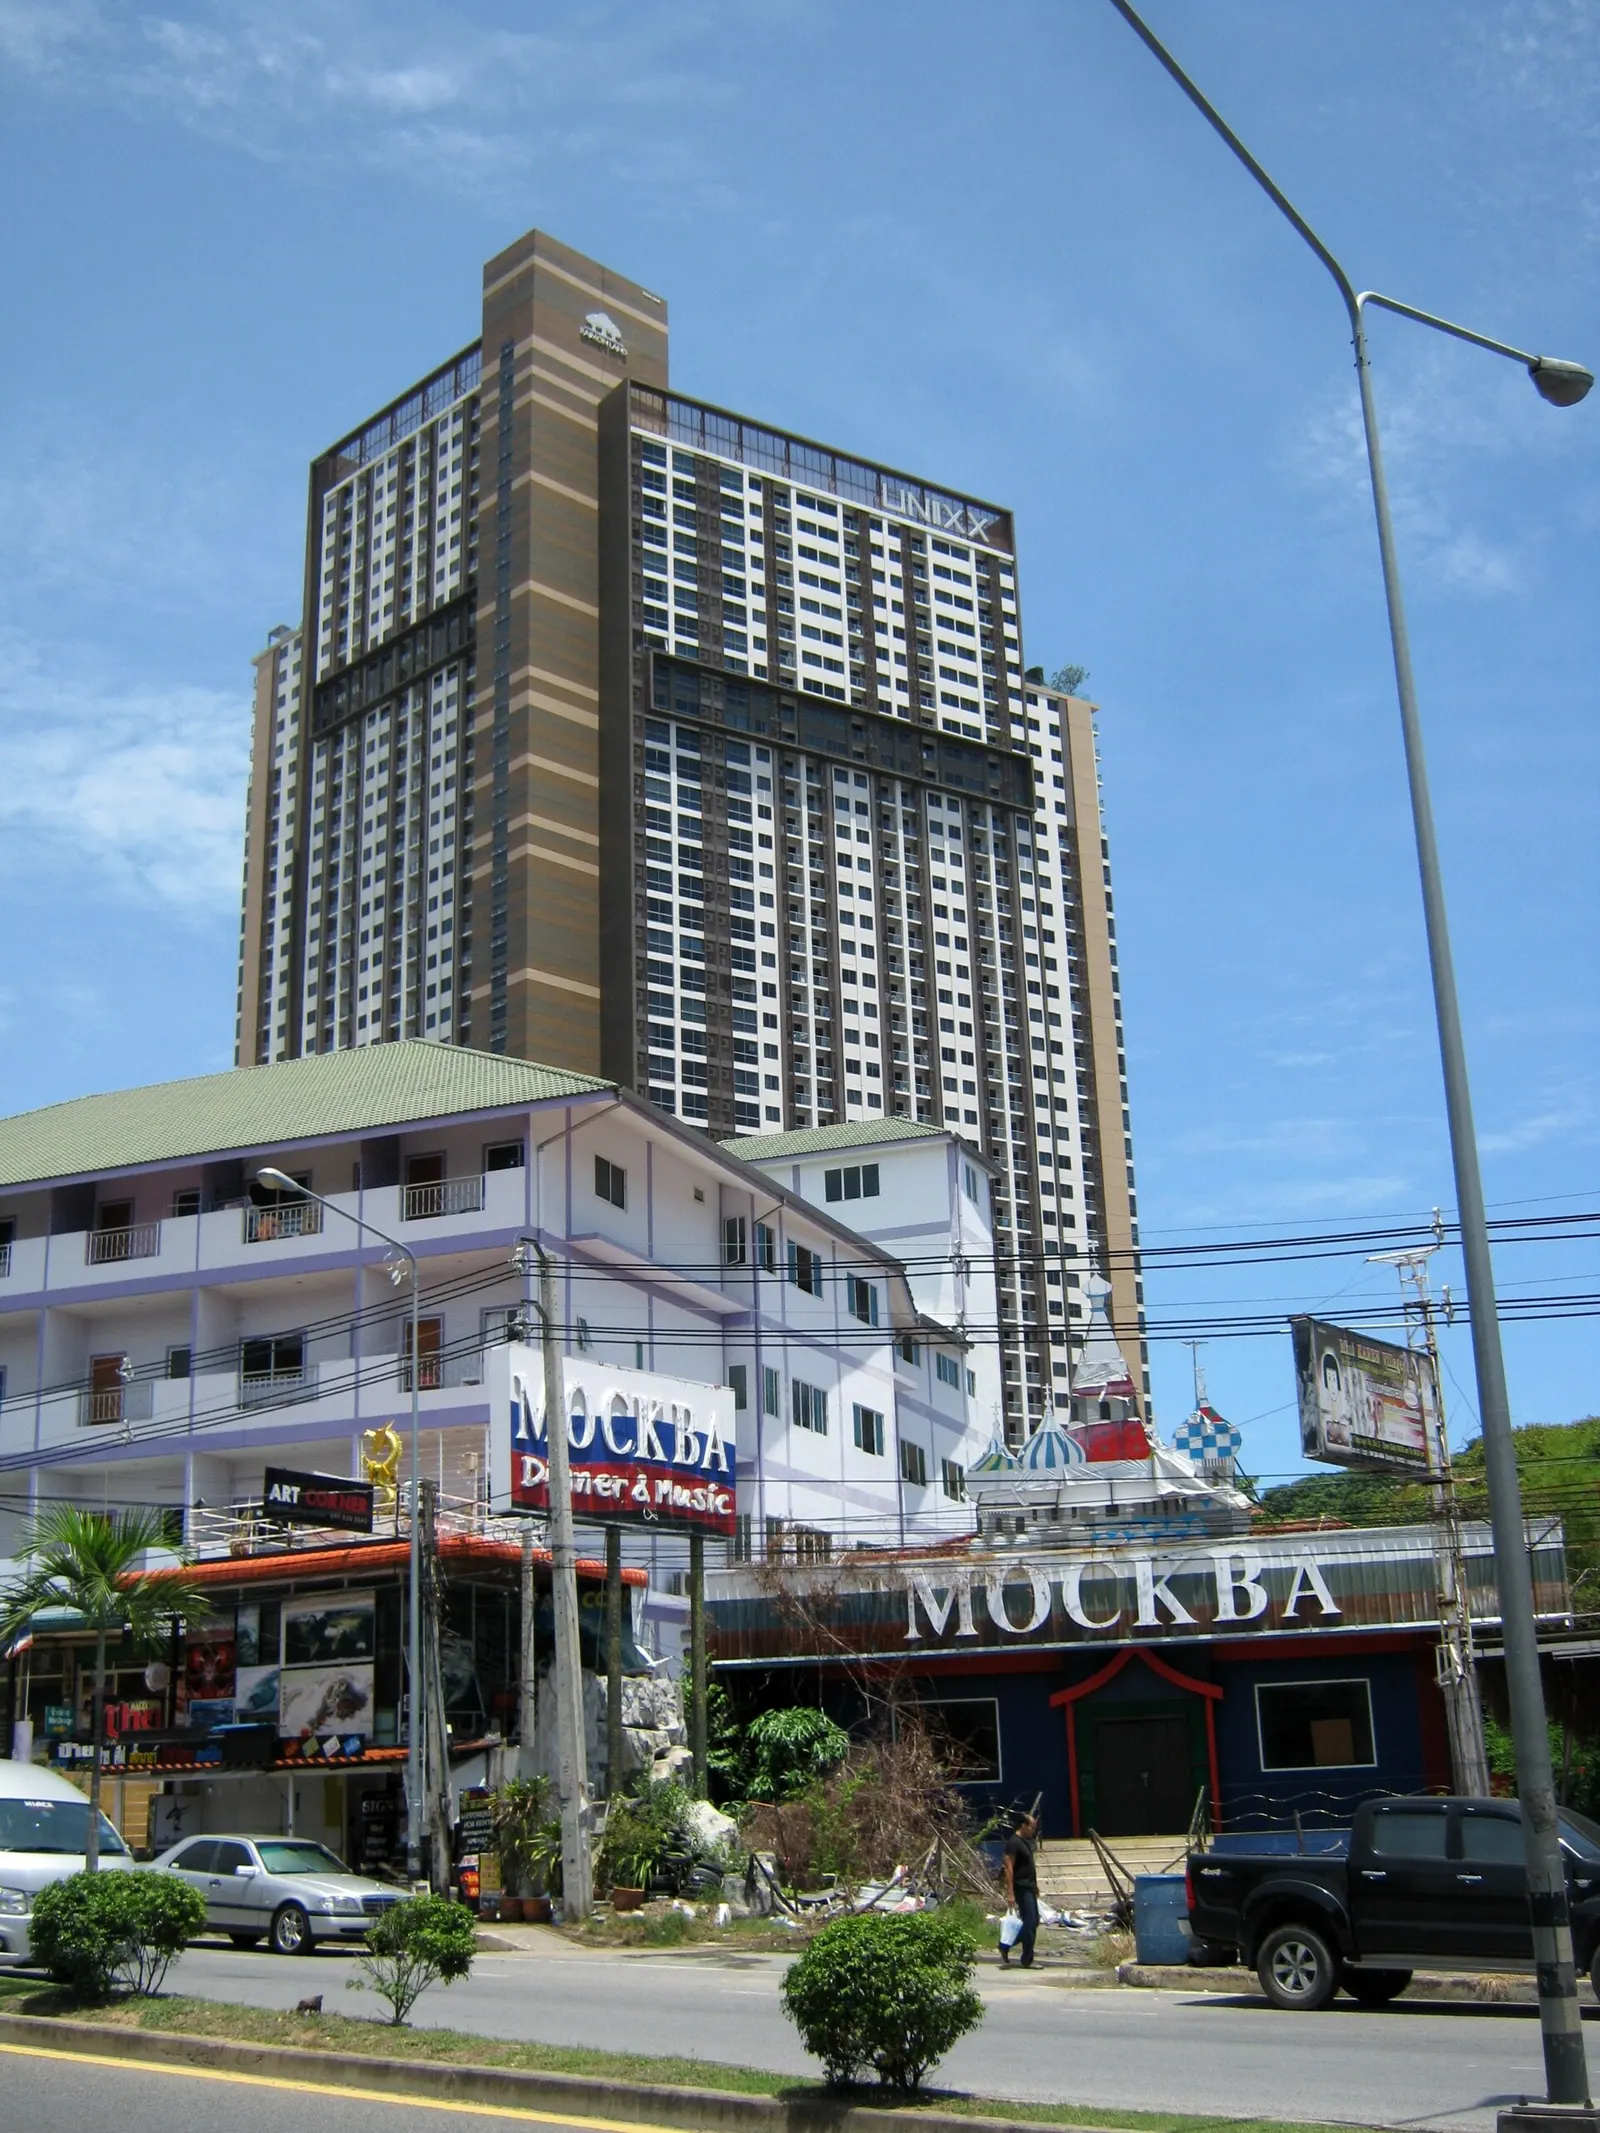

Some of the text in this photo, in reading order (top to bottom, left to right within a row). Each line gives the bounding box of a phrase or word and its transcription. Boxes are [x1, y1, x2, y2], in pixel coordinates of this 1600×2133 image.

[881, 482, 990, 543] UNIXX
[268, 1483, 301, 1504] ART
[305, 1488, 368, 1514] CORNER
[631, 1471, 651, 1503] &
[655, 1478, 735, 1515] Music
[902, 1545, 1344, 1641] МОСКВА
[362, 1799, 395, 1813] SIGN
